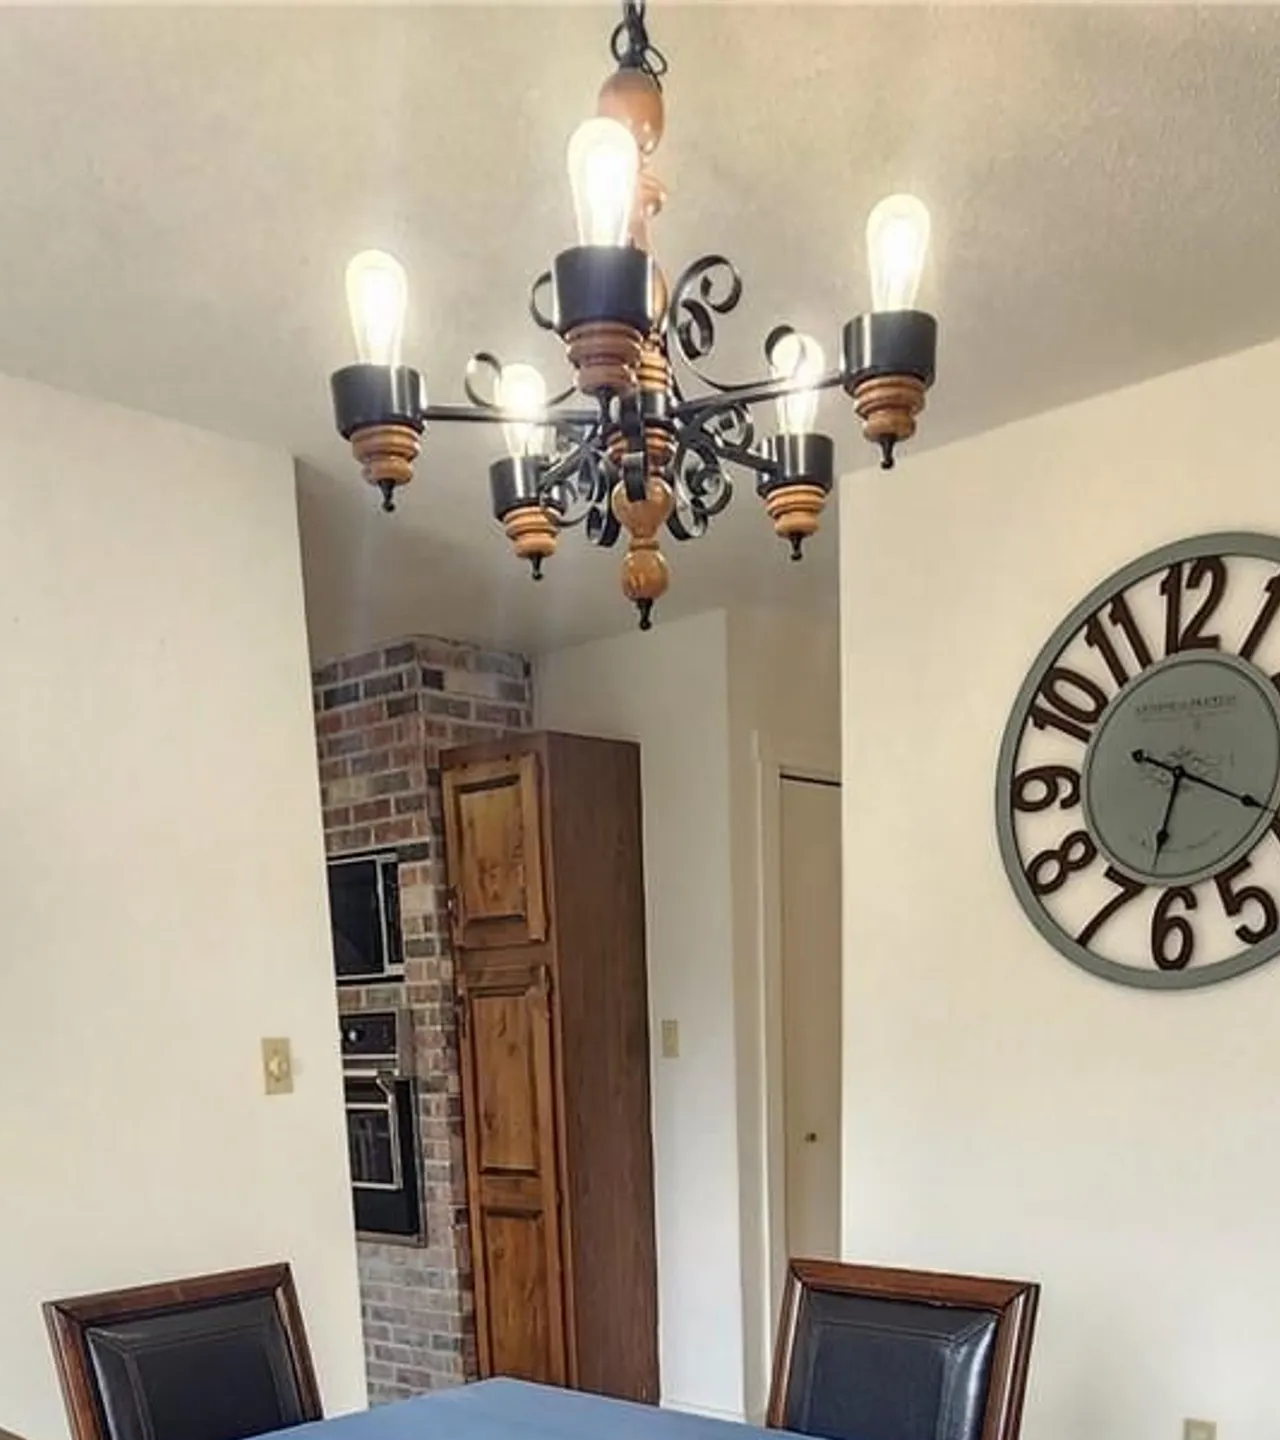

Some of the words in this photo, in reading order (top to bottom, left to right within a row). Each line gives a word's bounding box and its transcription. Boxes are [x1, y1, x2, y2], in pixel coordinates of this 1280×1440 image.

[1086, 593, 1152, 688] 11
[1160, 555, 1227, 656] 12
[1030, 667, 1108, 742] 10
[1013, 765, 1081, 812] 9
[1026, 830, 1097, 895] 8
[1215, 857, 1279, 943] 5
[1077, 867, 1147, 947] 7
[1151, 886, 1197, 970] 6
